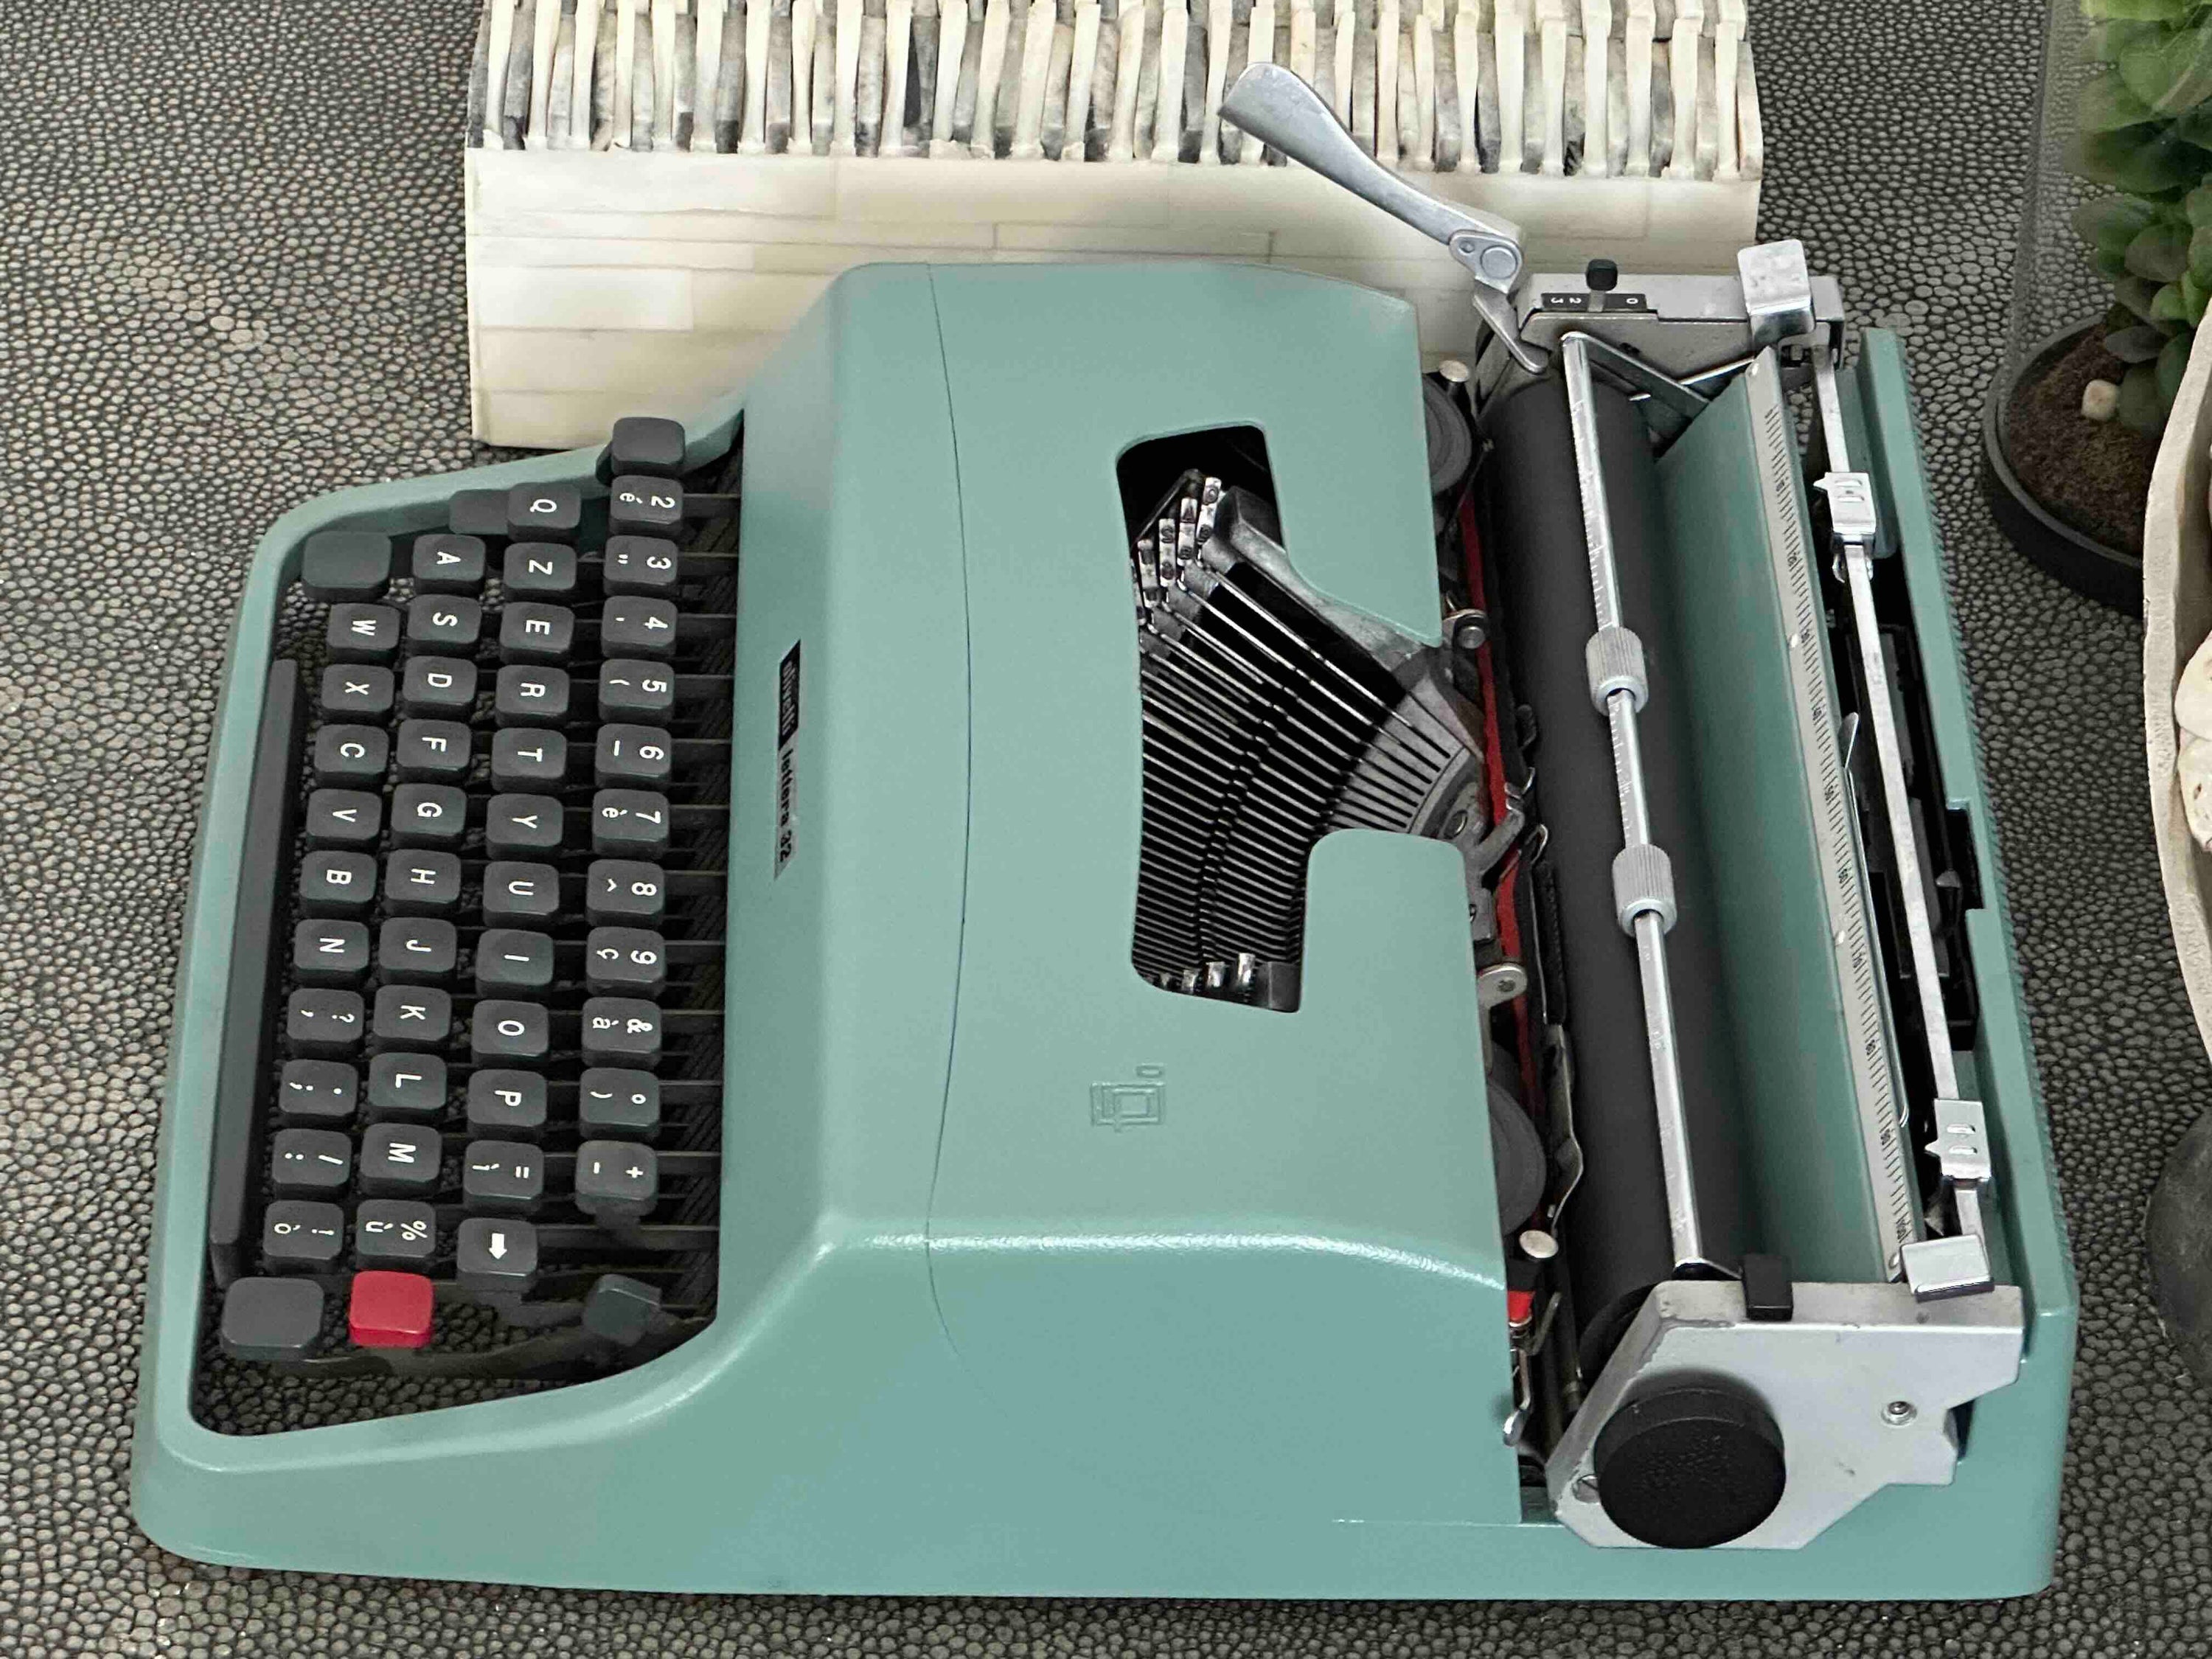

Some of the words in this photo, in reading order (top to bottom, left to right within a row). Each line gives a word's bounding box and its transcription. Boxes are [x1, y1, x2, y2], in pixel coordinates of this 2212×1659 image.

[529, 498, 557, 513] Q
[619, 493, 643, 504] é
[650, 495, 675, 509] 2
[436, 551, 462, 565] A
[646, 556, 672, 570] 3
[528, 559, 553, 575] Z
[432, 612, 458, 627] S
[644, 616, 668, 630] 4
[351, 619, 377, 636] W
[525, 619, 551, 636] E
[427, 672, 453, 688] D
[641, 679, 667, 693] 5
[344, 681, 370, 695] X
[520, 682, 546, 698] R
[781, 660, 796, 736] olivetti
[340, 742, 366, 759] C
[421, 737, 447, 752] F
[517, 748, 543, 762] T
[639, 745, 664, 760] 6
[780, 748, 793, 827] lettera
[332, 809, 358, 823] V
[417, 801, 442, 818] G
[602, 807, 628, 818] è
[635, 810, 661, 824] 7
[512, 815, 538, 829] Y
[779, 831, 792, 862] 32
[326, 869, 352, 885] B
[410, 868, 437, 885] H
[508, 880, 535, 896] U
[631, 882, 658, 897] 8
[319, 938, 345, 953] N
[406, 939, 432, 953] J
[504, 954, 530, 962] I
[596, 948, 619, 960] ç
[630, 950, 657, 965] 9
[331, 1013, 355, 1023] ?
[400, 1005, 426, 1020] K
[498, 1020, 525, 1037] O
[592, 1017, 619, 1029] à
[627, 1018, 653, 1034] &
[289, 1082, 313, 1091] ;
[394, 1074, 422, 1088] L
[494, 1090, 522, 1107] P
[285, 1152, 305, 1161] :
[318, 1155, 344, 1165] /
[387, 1142, 417, 1164] M
[515, 1166, 529, 1179] =
[625, 1166, 644, 1179] +
[274, 1222, 301, 1234] ò
[365, 1221, 394, 1233] ù
[400, 1220, 428, 1241] %
